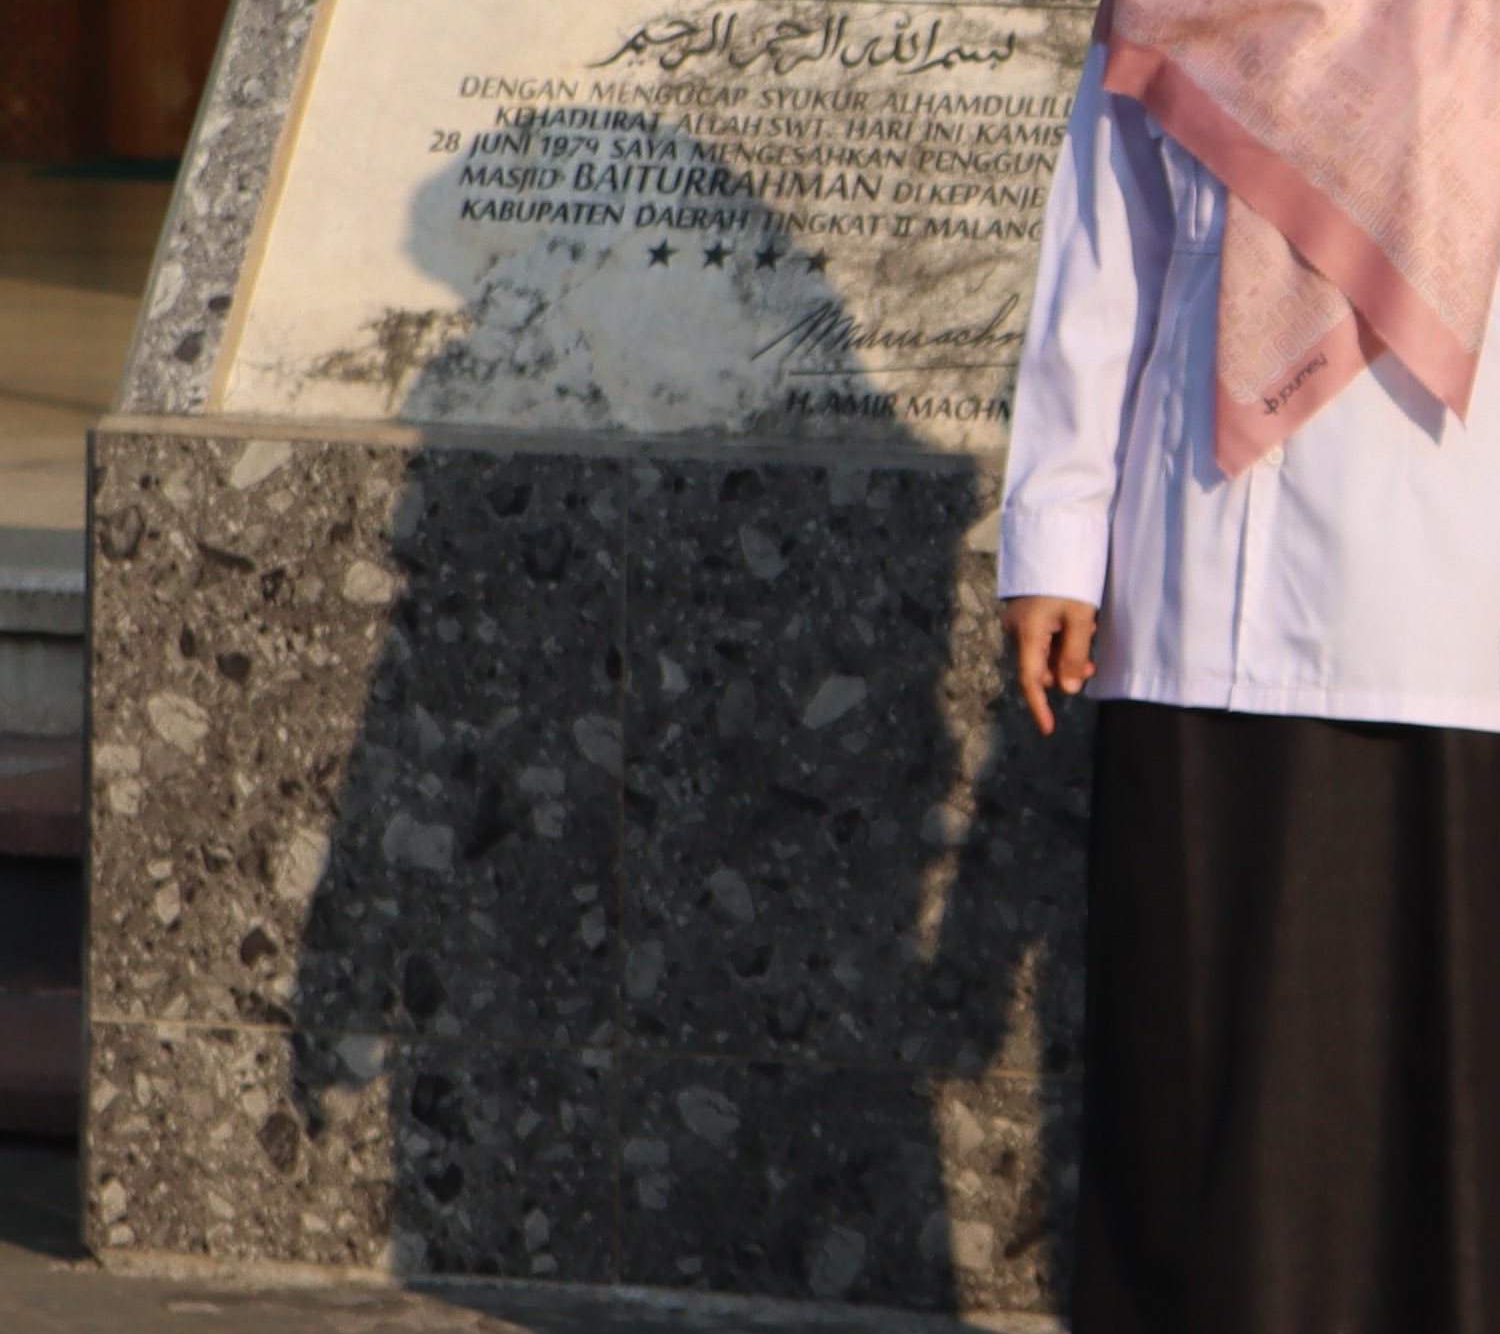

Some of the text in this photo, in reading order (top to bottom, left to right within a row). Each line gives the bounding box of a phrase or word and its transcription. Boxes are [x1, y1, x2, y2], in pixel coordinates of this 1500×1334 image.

[459, 76, 579, 101] DENGAN
[589, 79, 750, 107] MENGUCAP
[760, 86, 870, 112] SYUKUR
[495, 105, 661, 133] KEHADLIRAT
[674, 112, 762, 137] ALLAH
[846, 117, 912, 141] HARI
[923, 121, 964, 144] INI
[974, 122, 1069, 148] KAMIS
[430, 129, 1058, 175] 28 JUNI 1979 SAYA MENGESAHKAN PENGGUN
[459, 164, 561, 195] MASJID
[572, 161, 882, 203] BAITURRAHMAN
[927, 183, 1048, 212] KEPANJE
[460, 198, 625, 227] KABUPATEN
[634, 204, 750, 233] DAERAH
[762, 210, 884, 237] TINGKAT
[822, 392, 899, 419] AMIR
